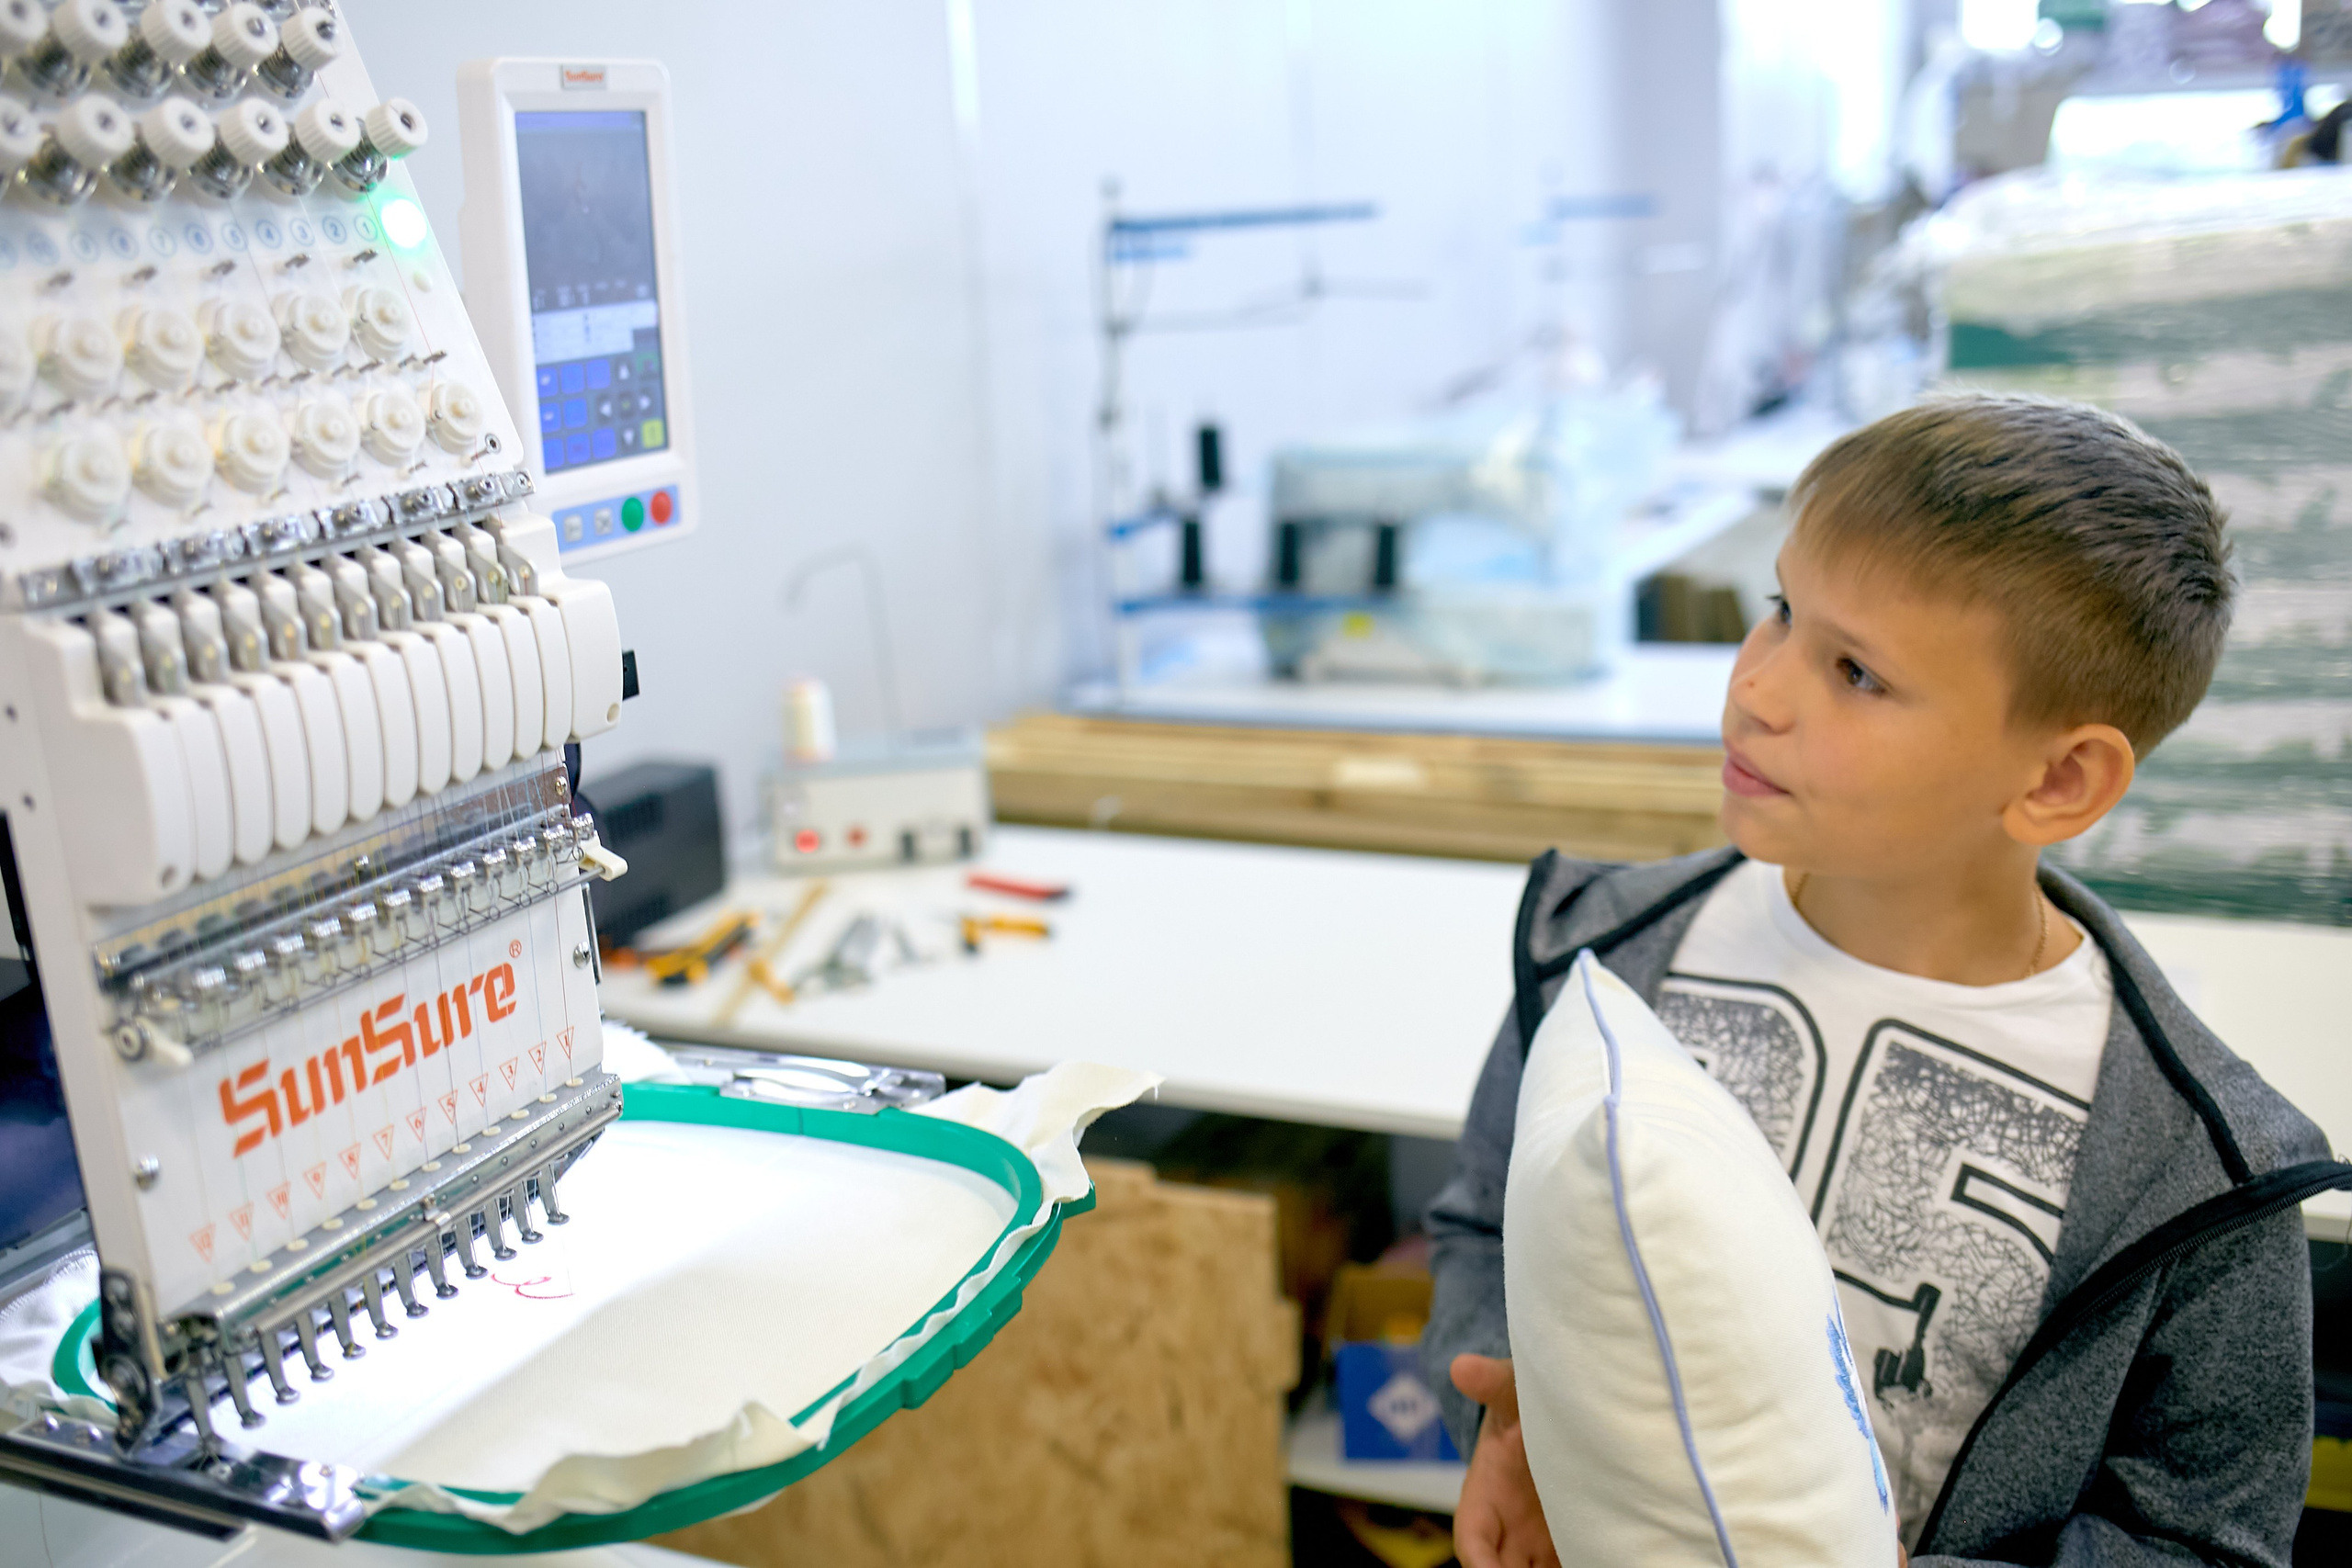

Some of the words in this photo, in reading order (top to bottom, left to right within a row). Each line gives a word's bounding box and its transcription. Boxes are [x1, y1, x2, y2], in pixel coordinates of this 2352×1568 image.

[219, 962, 517, 1158] SunSure
[413, 1114, 423, 1130] 6
[447, 1100, 456, 1113] 5
[476, 1081, 485, 1094] 4
[506, 1065, 514, 1078] 3
[536, 1049, 544, 1062] 2
